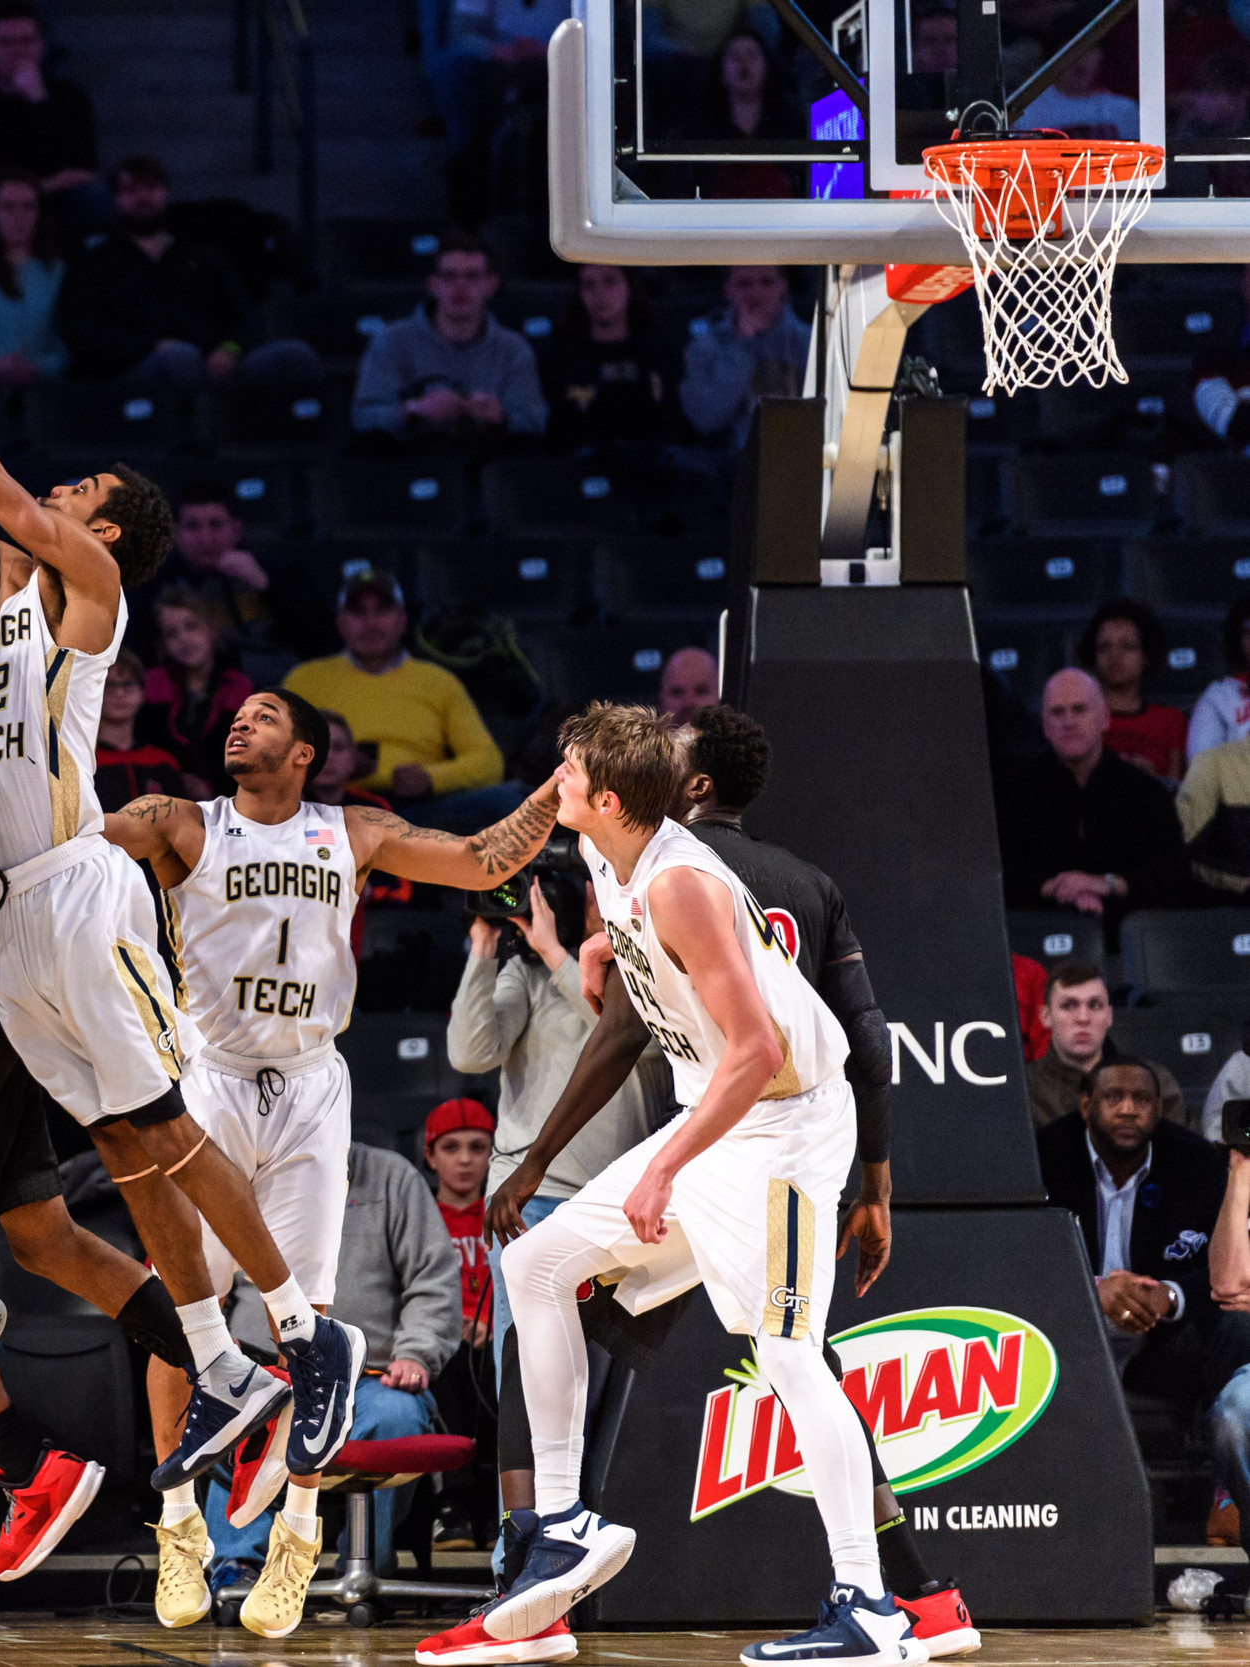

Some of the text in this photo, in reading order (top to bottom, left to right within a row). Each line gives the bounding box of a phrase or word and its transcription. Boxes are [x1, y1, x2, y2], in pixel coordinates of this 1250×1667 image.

[225, 861, 342, 909] GEORGIA
[276, 916, 291, 966] 1
[233, 975, 316, 1018] TECH
[623, 968, 666, 1021] 44
[647, 1020, 701, 1063] ECH
[886, 1020, 1007, 1086] NC
[770, 1286, 809, 1314] GT
[914, 1504, 1059, 1530] IN CLEANING
